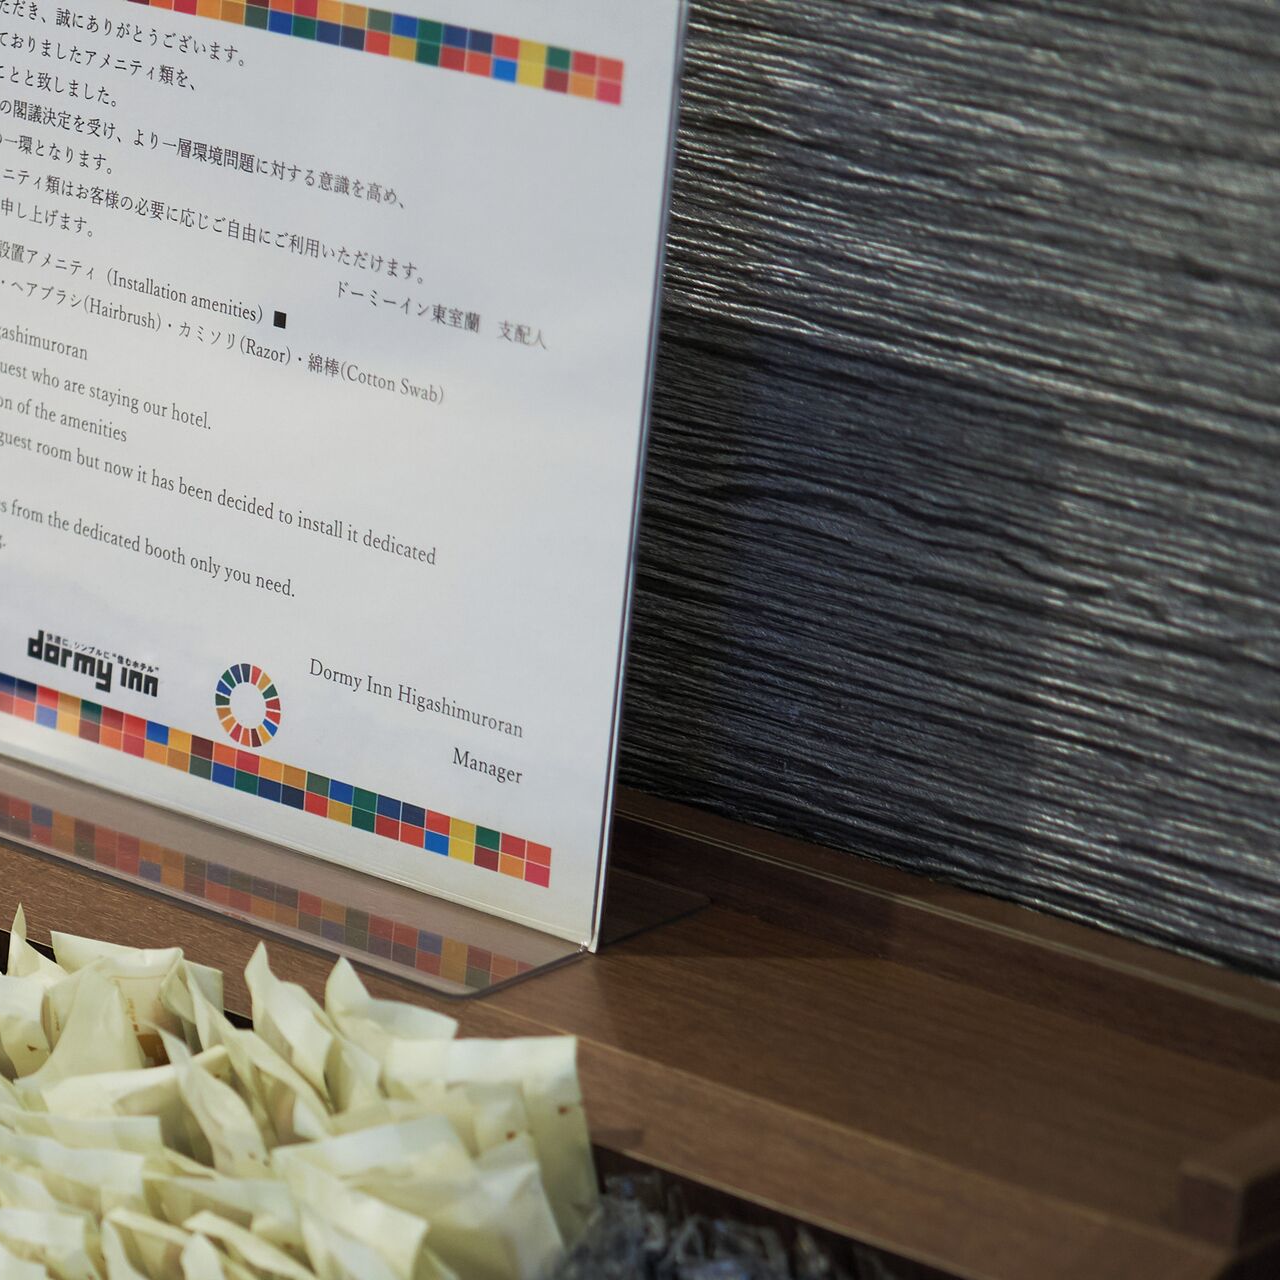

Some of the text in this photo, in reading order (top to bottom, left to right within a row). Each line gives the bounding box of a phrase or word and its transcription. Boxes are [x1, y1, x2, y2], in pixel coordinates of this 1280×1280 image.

[106, 266, 187, 305] (Installation
[191, 293, 263, 324] amenities)
[15, 397, 33, 416] of
[33, 400, 57, 423] the
[59, 413, 127, 443] amenities
[30, 366, 60, 389] who
[62, 378, 86, 395] are
[88, 385, 139, 415] staying
[142, 400, 168, 417] our
[170, 401, 211, 430] hotel.
[399, 377, 444, 405] Swab)
[35, 441, 72, 463] room
[75, 446, 100, 470] but
[103, 460, 134, 479] now
[136, 464, 147, 484] it
[150, 467, 174, 492] has
[177, 475, 213, 503] been
[216, 487, 274, 520] decided
[277, 508, 293, 525] to
[296, 509, 343, 539] install
[346, 523, 358, 543] it
[361, 528, 436, 566] dedicated
[10, 497, 43, 524] from
[47, 509, 70, 532] the
[72, 516, 141, 553] dedicated
[144, 536, 186, 566] booth
[189, 554, 221, 579] only
[223, 566, 251, 585] you
[254, 574, 295, 598] need.
[27, 629, 159, 698] dormy inn
[308, 657, 523, 738] Dormy Inn Higashimuroran
[451, 746, 523, 784] Manager
